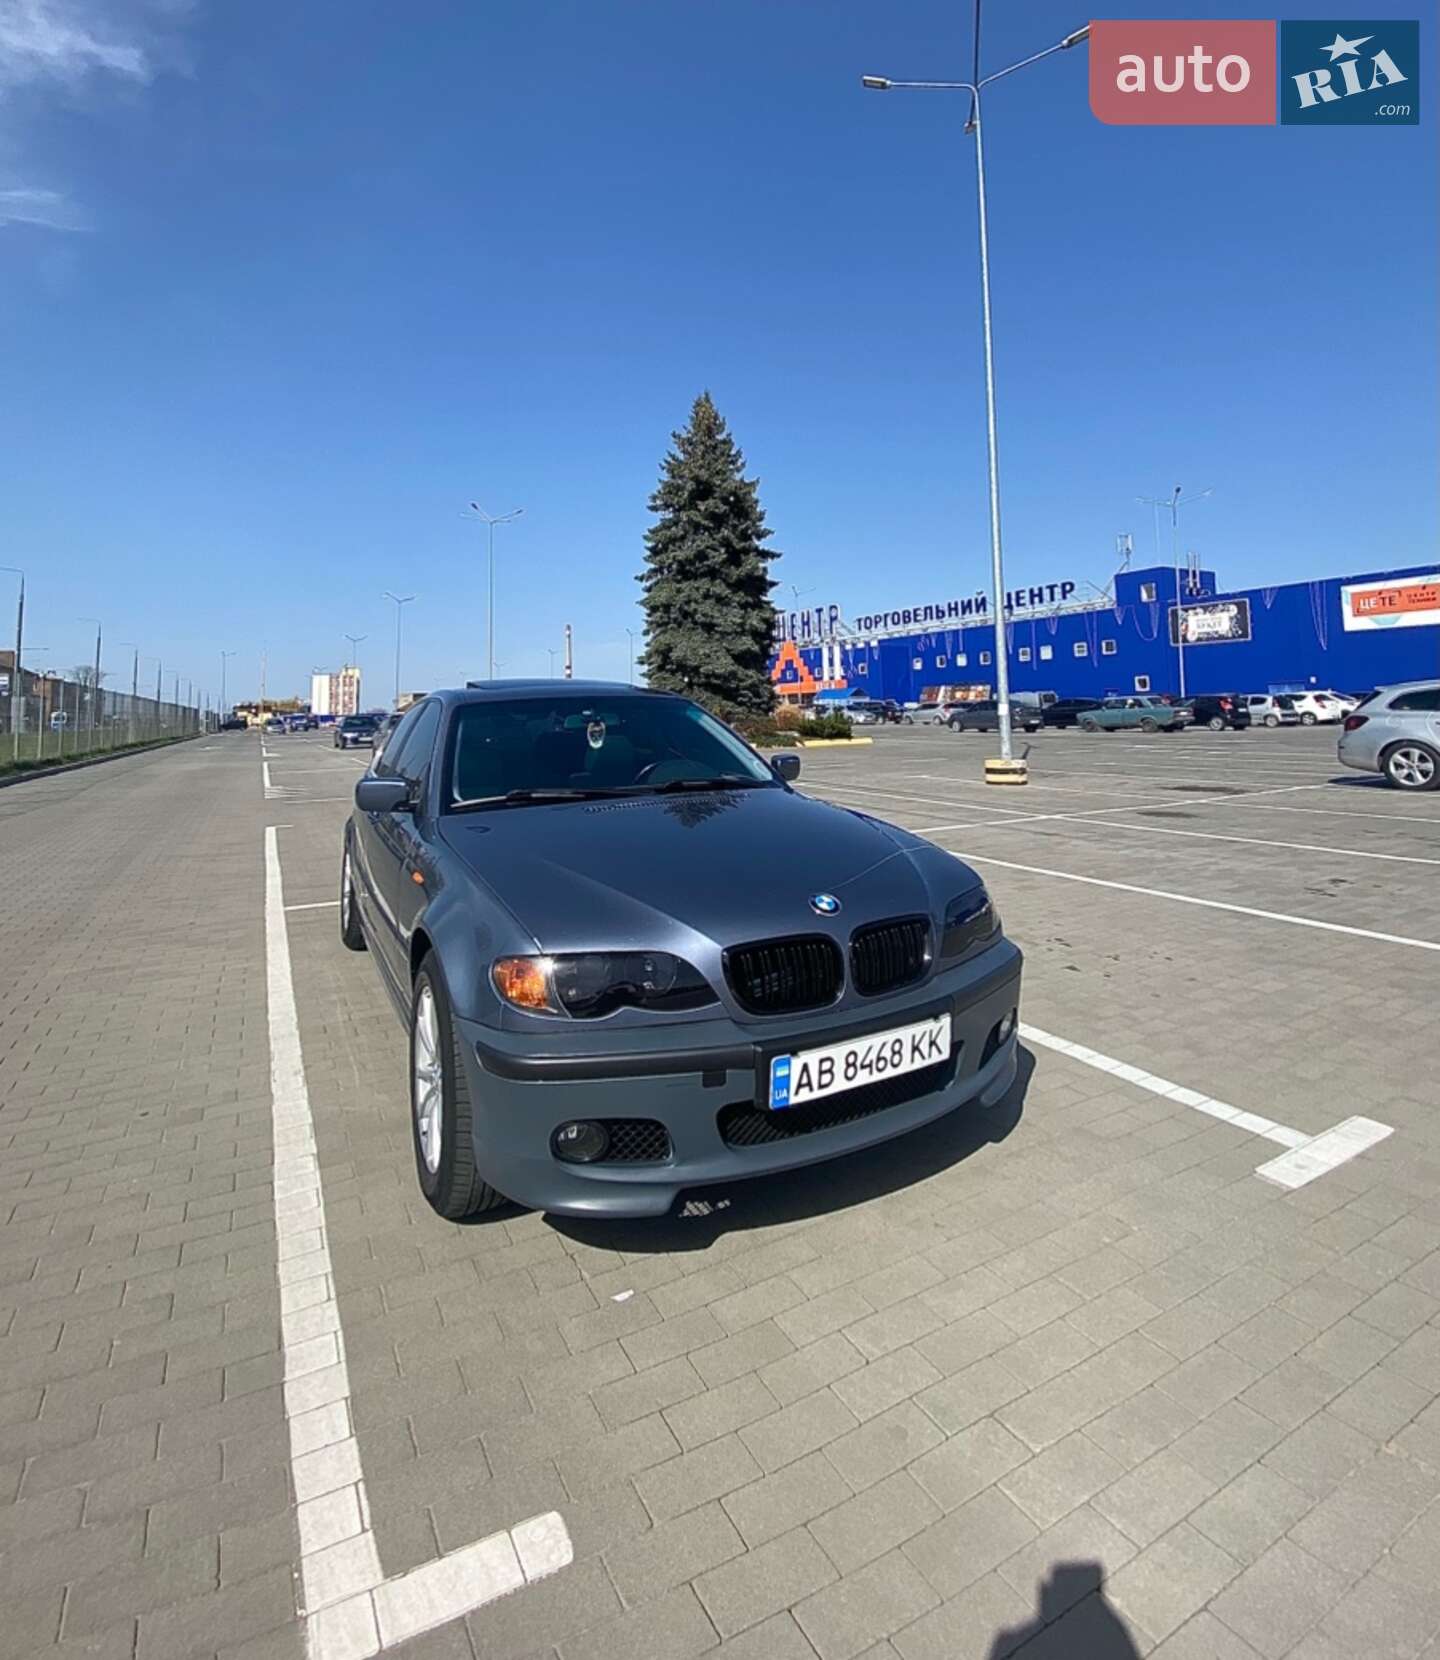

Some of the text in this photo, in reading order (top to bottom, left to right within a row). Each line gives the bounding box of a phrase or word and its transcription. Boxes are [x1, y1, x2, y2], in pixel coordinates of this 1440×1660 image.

[856, 591, 988, 632] ТОРГОВЕЛЬНИЙ
[794, 1025, 944, 1097] AB 8468 KK
[775, 1090, 788, 1101] UA
